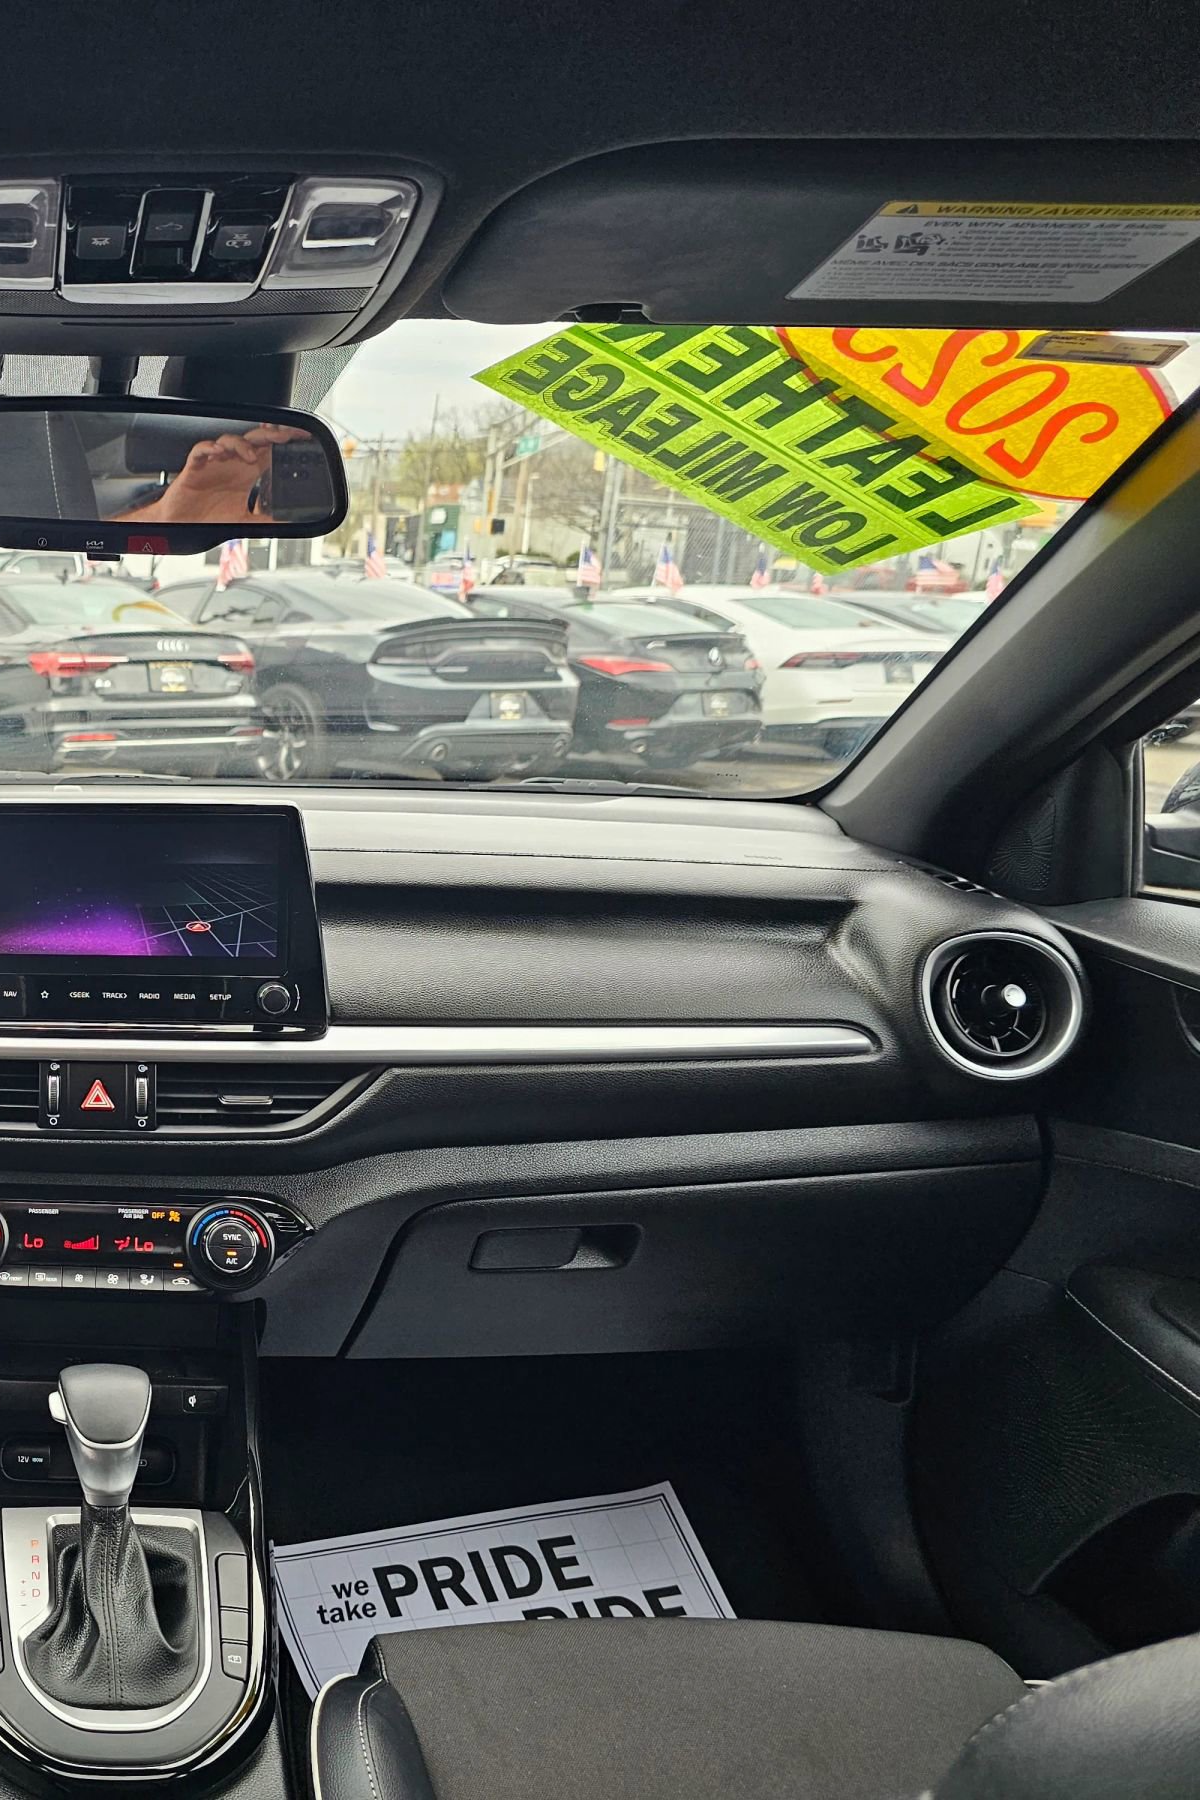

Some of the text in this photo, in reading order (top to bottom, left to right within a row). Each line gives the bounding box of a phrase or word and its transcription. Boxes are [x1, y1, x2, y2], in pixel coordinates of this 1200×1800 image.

[138, 992, 160, 1000] RADIO
[222, 1233, 242, 1241] SYNC
[225, 1257, 238, 1265] A/C
[17, 1455, 30, 1463] 12V
[31, 1540, 39, 1548] P
[31, 1555, 40, 1564] R
[31, 1571, 40, 1580] N
[372, 1535, 594, 1619] PRIDE
[32, 1588, 40, 1598] D
[332, 1580, 369, 1600] we
[317, 1601, 377, 1625] take
